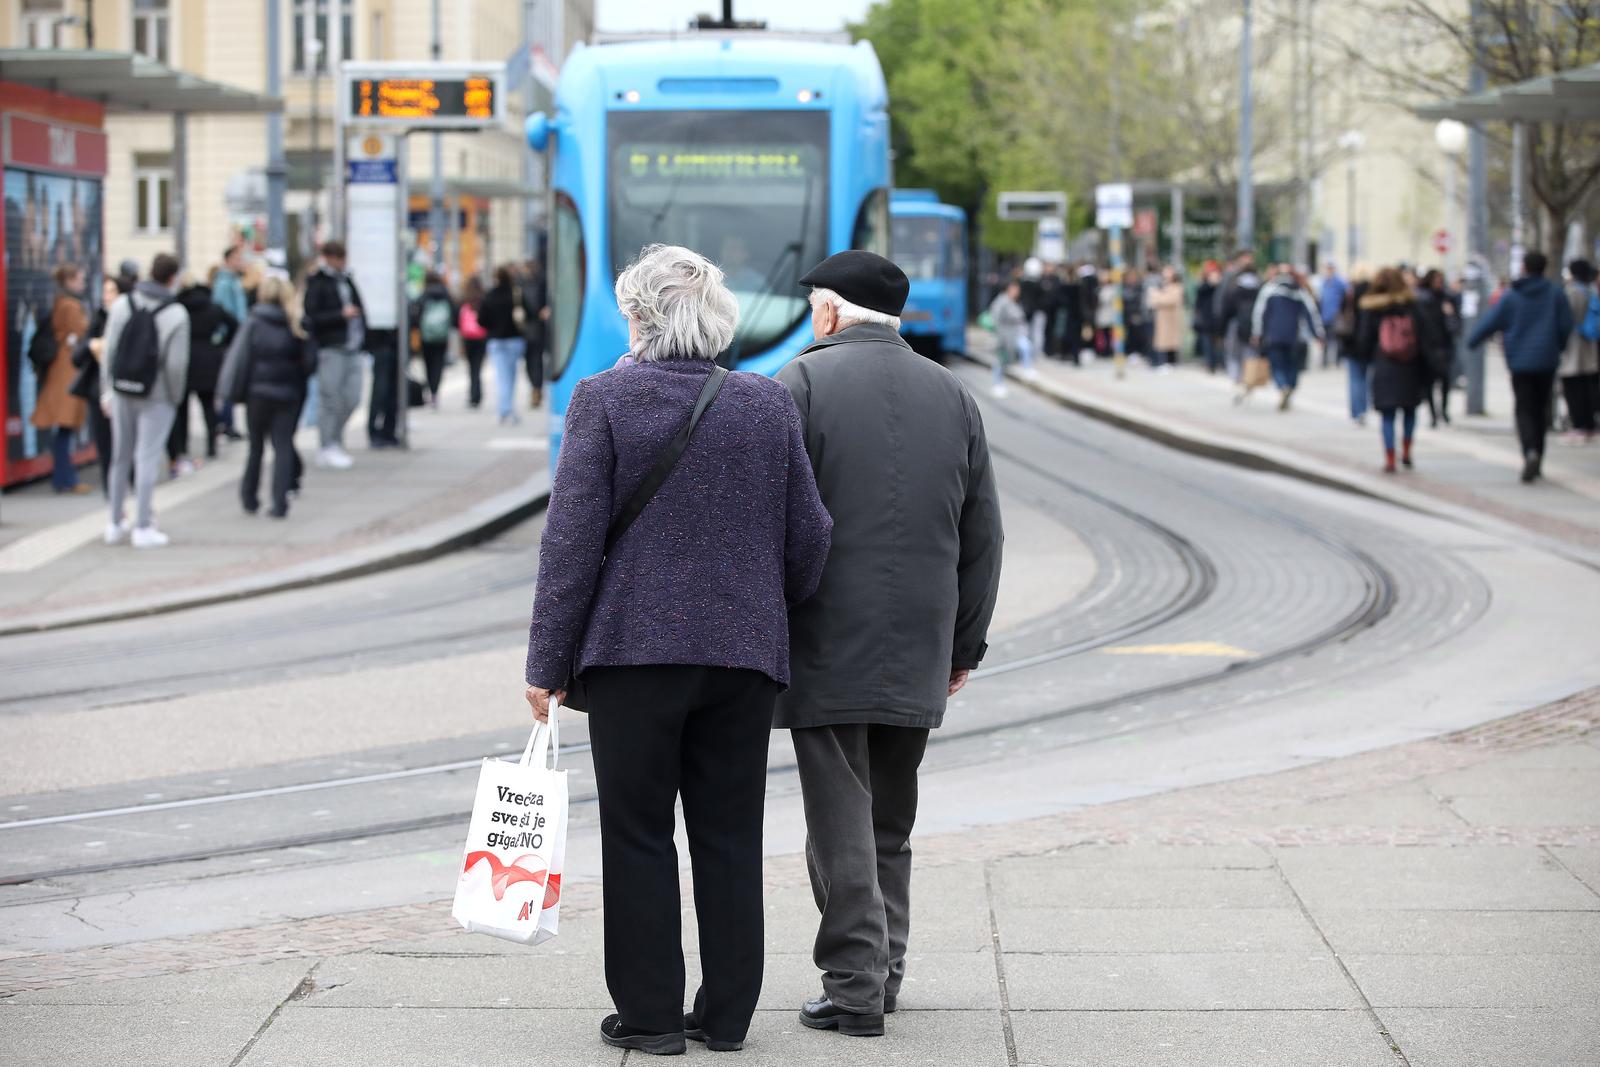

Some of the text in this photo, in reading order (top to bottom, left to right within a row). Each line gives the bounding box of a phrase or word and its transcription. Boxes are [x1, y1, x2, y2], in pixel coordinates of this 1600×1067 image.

[491, 811, 519, 826] sve
[532, 812, 546, 831] je
[516, 899, 534, 922] A1
